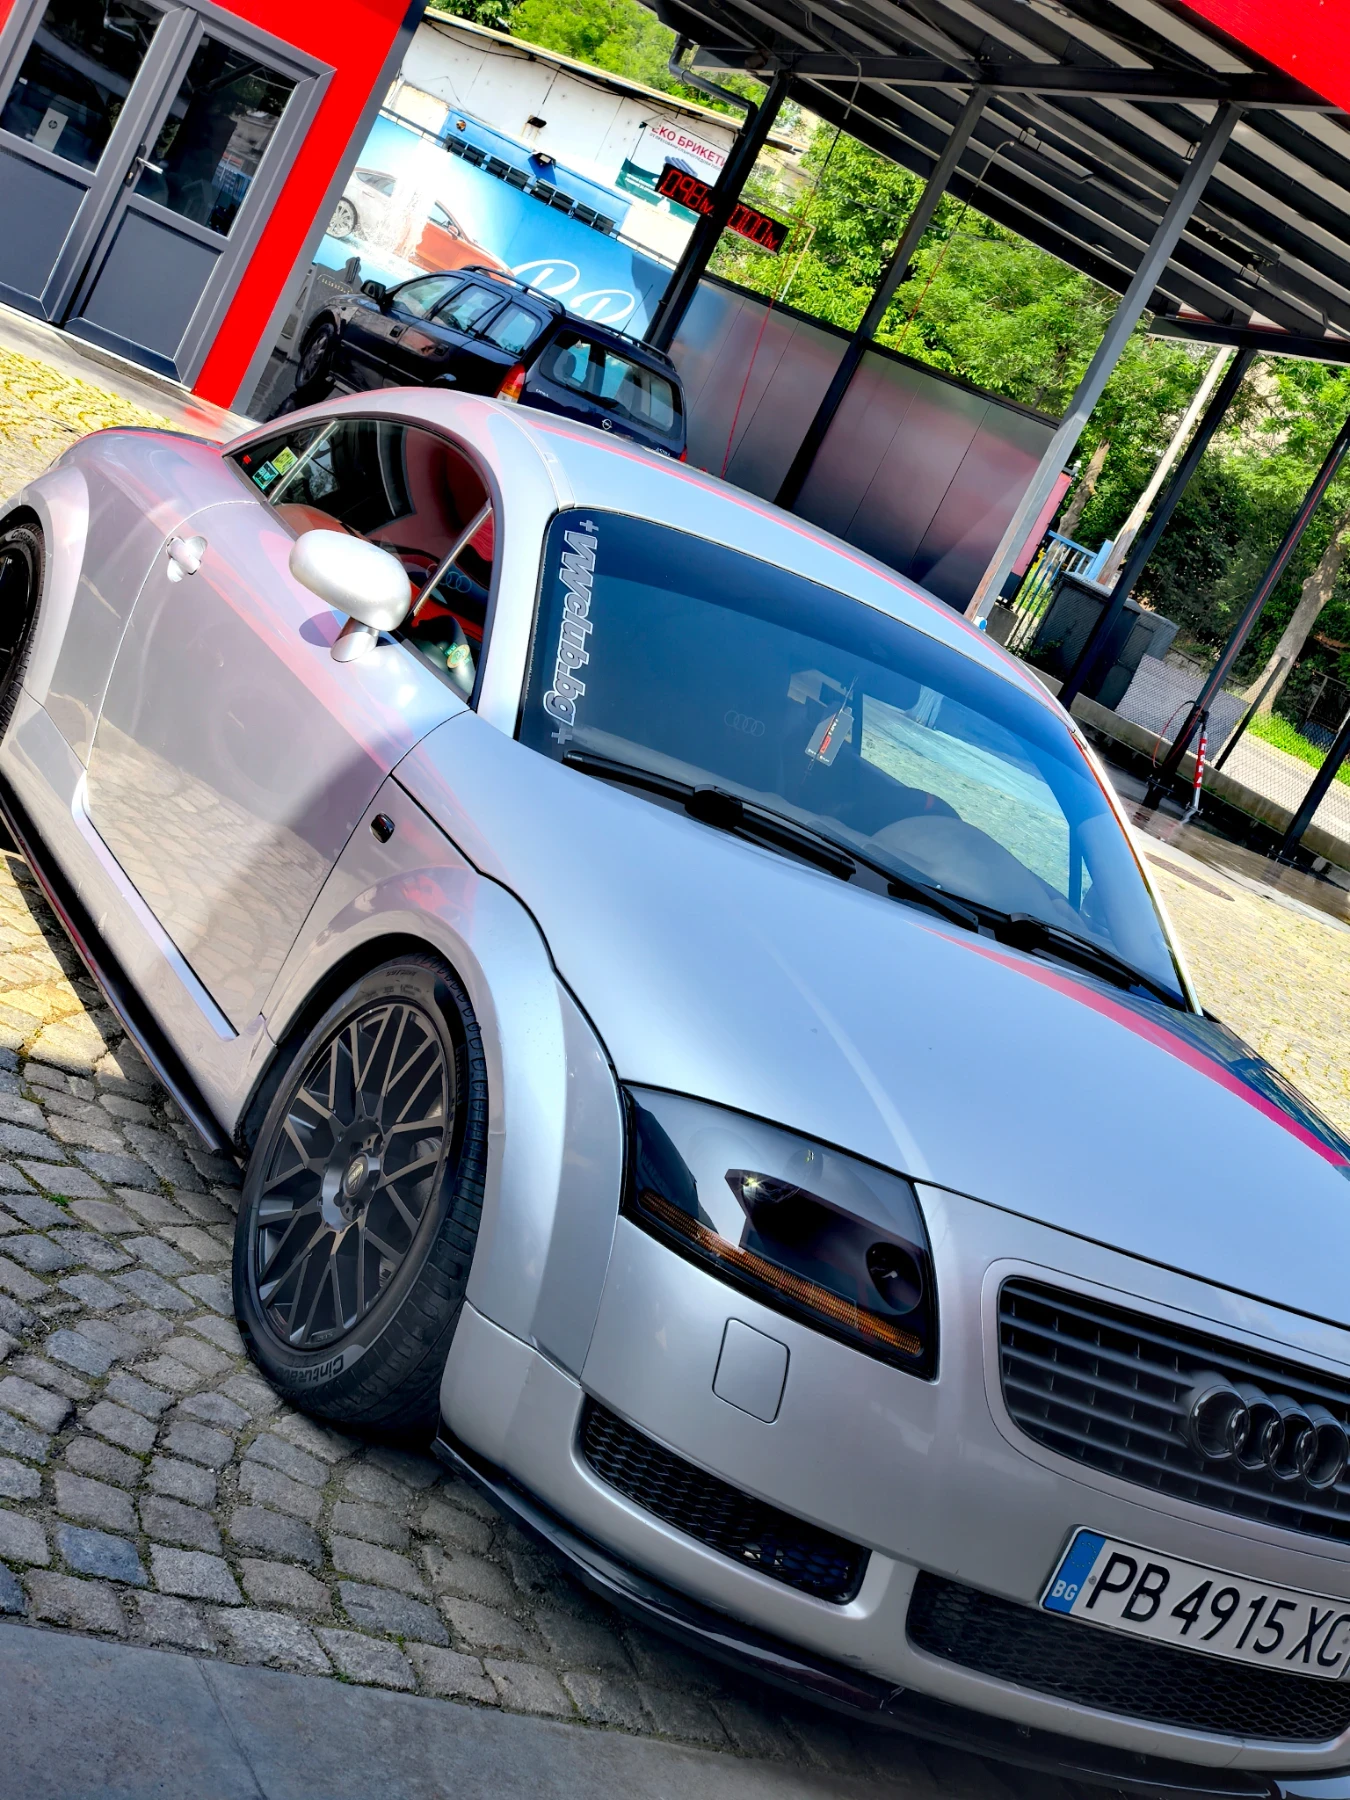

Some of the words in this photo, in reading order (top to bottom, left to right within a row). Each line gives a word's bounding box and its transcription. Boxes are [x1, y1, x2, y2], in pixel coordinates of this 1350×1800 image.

[543, 530, 598, 726] VWclub.bg
[1051, 1579, 1079, 1601] BG
[1170, 1580, 1298, 1654] 4915
